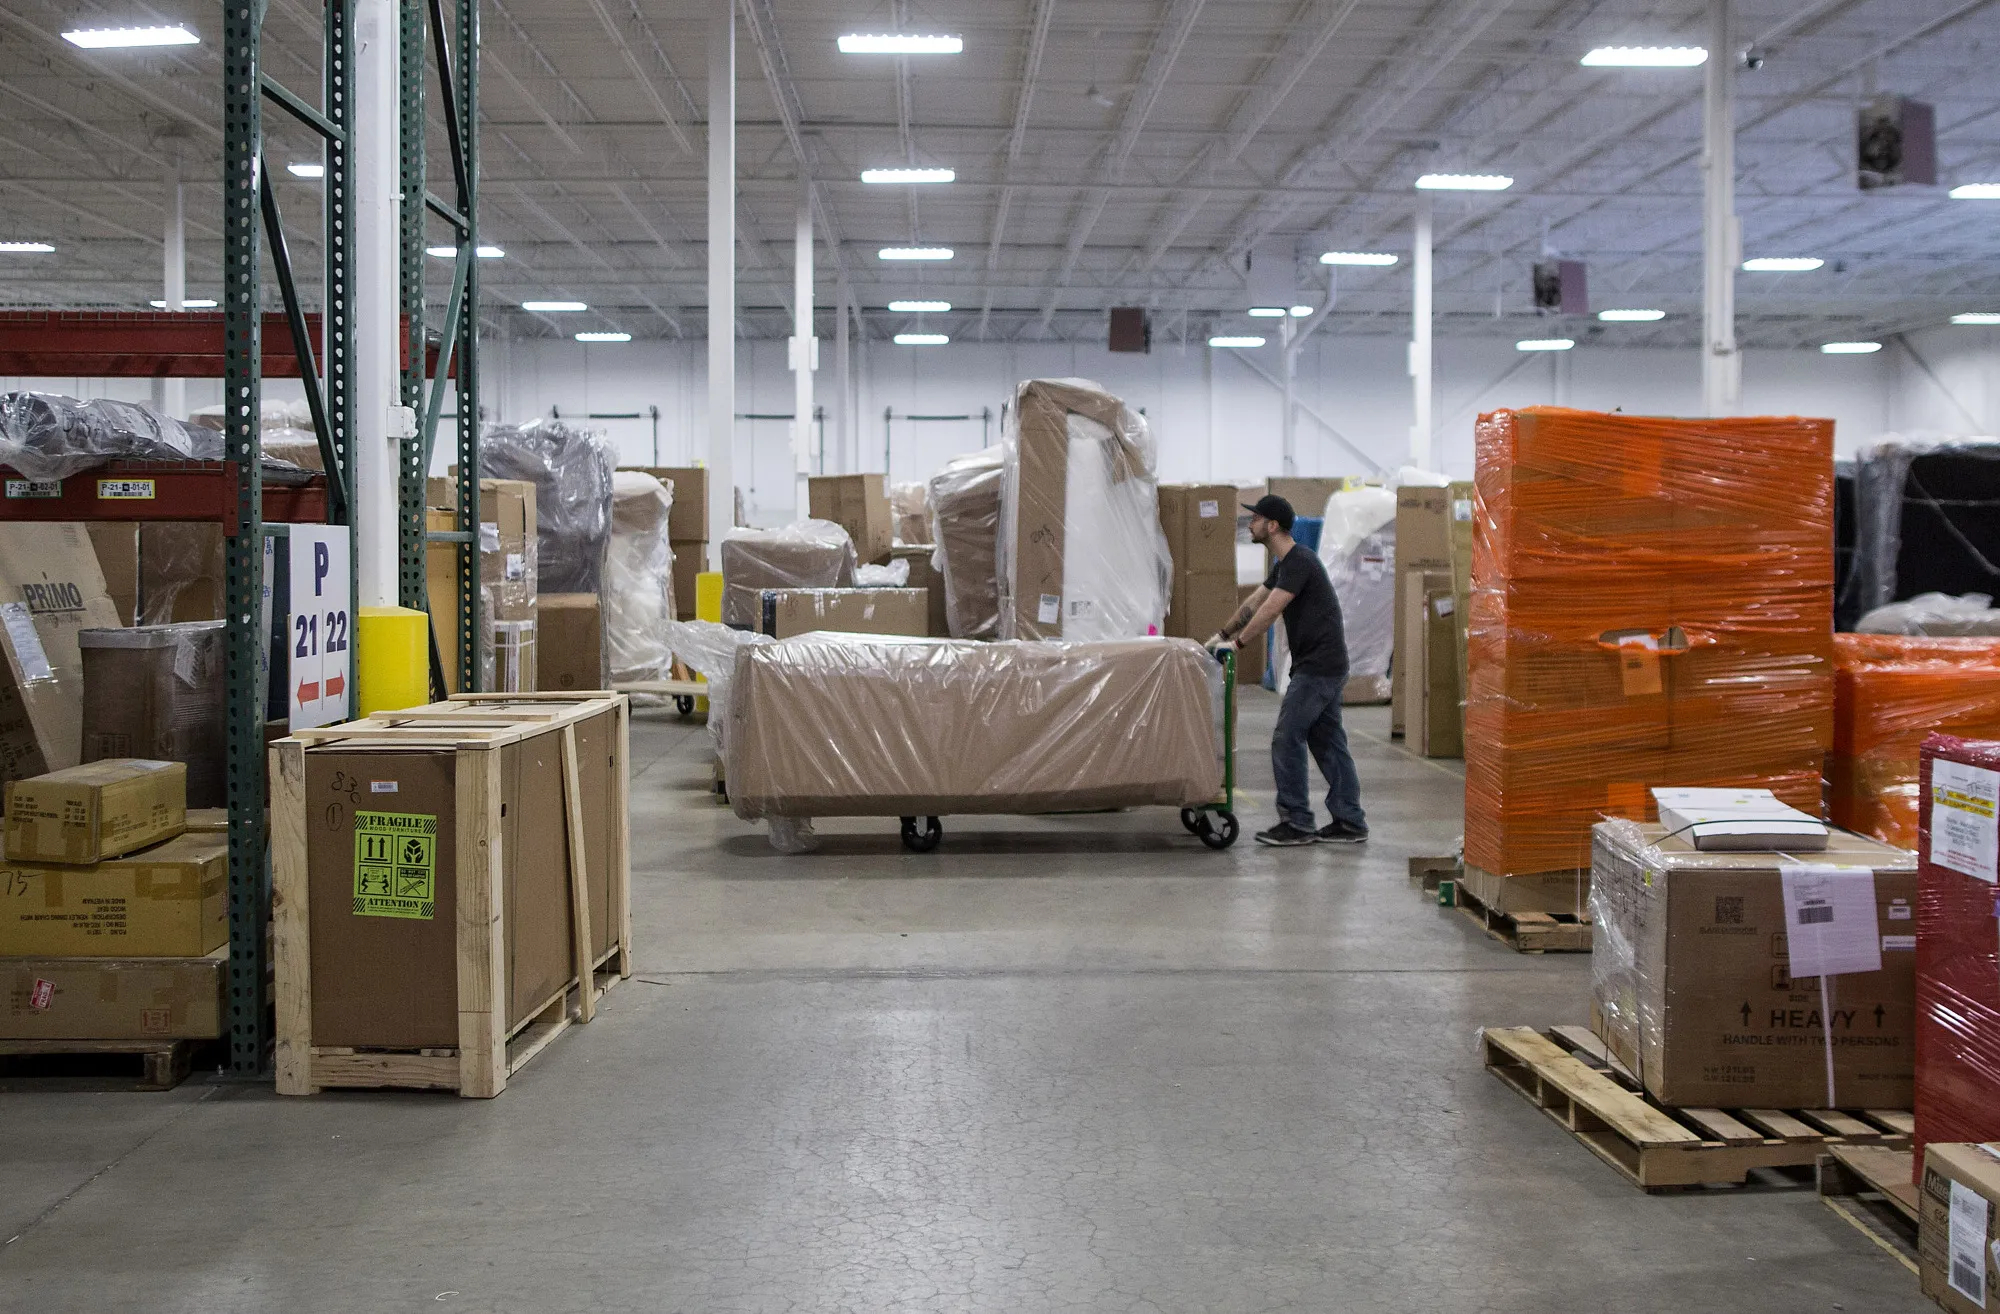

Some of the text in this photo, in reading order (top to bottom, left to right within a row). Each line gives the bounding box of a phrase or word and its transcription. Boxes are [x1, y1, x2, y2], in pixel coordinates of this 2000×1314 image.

[101, 483, 150, 491] P-21--01-01
[314, 541, 330, 596] P
[295, 614, 318, 659] 21
[326, 611, 348, 652] 22
[369, 815, 423, 829] FRAGILE
[367, 898, 419, 908] ATTENTION
[1723, 1034, 1773, 1046] HANDLE
[1775, 1034, 1808, 1046] WITH
[1841, 1036, 1900, 1047] PERSONS
